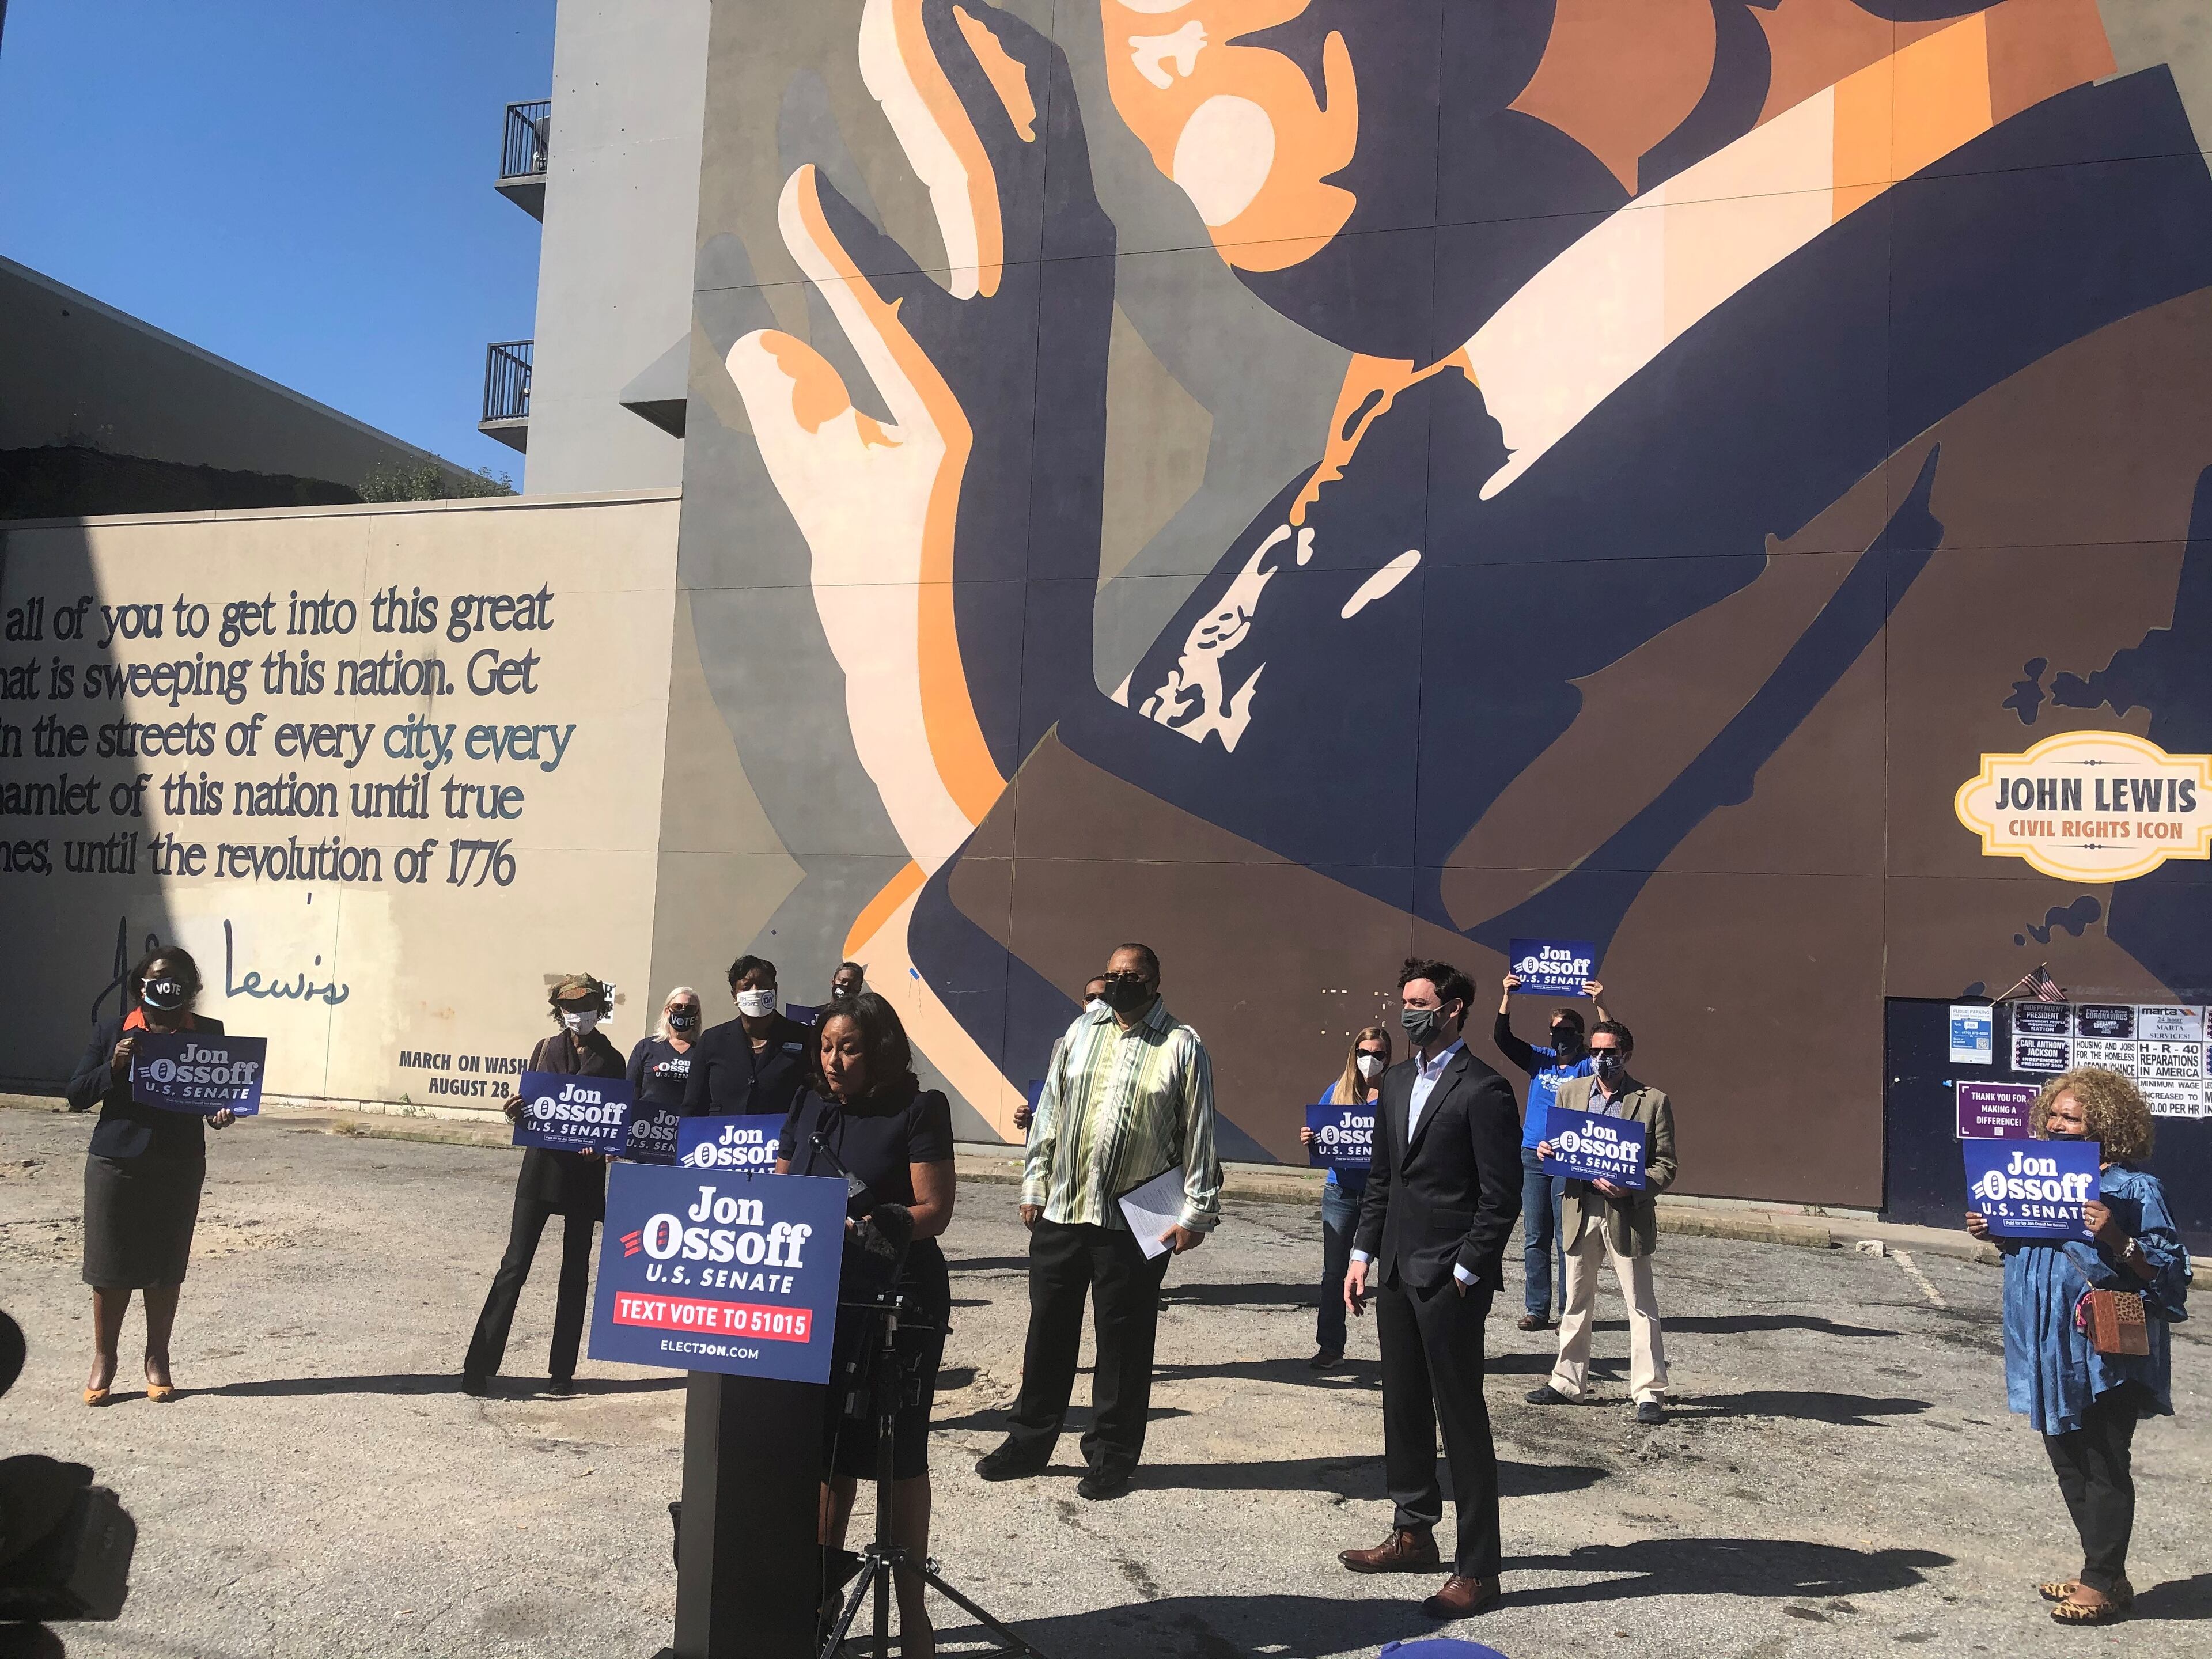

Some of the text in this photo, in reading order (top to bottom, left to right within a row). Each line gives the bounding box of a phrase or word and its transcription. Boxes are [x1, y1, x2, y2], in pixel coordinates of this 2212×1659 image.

[6, 582, 554, 649] all of you to get into this great
[48, 656, 74, 700] is
[83, 651, 252, 707] sweeping
[261, 650, 325, 695] this
[334, 647, 454, 695] nation.
[467, 647, 540, 694] Get
[0, 712, 576, 772] n the streets of every city, every
[0, 771, 525, 819] amlet of this nation until true
[1995, 778, 2196, 812] JOHN LEWIS
[2009, 820, 2183, 839] CIVIL RIGHTS ICON
[64, 831, 139, 875] until
[148, 833, 207, 876] the
[215, 835, 383, 882] revolution
[394, 839, 435, 884] of
[446, 837, 516, 888] 1776
[223, 919, 349, 1005] Lewis
[1540, 946, 1571, 960] Jon
[1522, 956, 1591, 976] Ossoff
[156, 982, 181, 995] VOTE
[1520, 974, 1587, 986] U.S. SENATE
[671, 1014, 695, 1027] VOTE
[2027, 1012, 2059, 1020] PRESIDENT
[2086, 1012, 2128, 1021] CORONAVIRUS
[180, 1044, 229, 1064] Jon
[2027, 1049, 2058, 1058] JACKSON
[2037, 1041, 2065, 1049] ANTHONY
[2077, 1040, 2135, 1051] HOUSING AND JOBS
[2140, 1044, 2198, 1054] H R 40
[399, 1051, 529, 1075] MARCH ON WASH
[2077, 1051, 2135, 1061] FOR THE HOMELESS
[2141, 1054, 2198, 1067] REPARATIONS
[150, 1059, 259, 1085] Ossoff
[2141, 1067, 2199, 1077] IN AMERICA
[146, 1081, 249, 1099] U.S. SENATE
[429, 1077, 487, 1097] AUGUST
[559, 1083, 601, 1104] Jon
[2140, 1080, 2174, 1088] MINIMUM
[1971, 1092, 2027, 1103] THANK YOU FOR
[533, 1096, 627, 1125] Ossoff
[1982, 1105, 2017, 1114] MAKING A
[2169, 1103, 2186, 1114] PER
[2188, 1104, 2199, 1115] HR
[527, 1120, 618, 1139] U.S. SENATE
[632, 1119, 676, 1141] Oss
[1340, 1112, 1375, 1128] Jon
[1976, 1116, 2021, 1127] DIFFERENCE!
[719, 1125, 763, 1145] Jon
[1581, 1120, 1618, 1142] Jon
[626, 1138, 649, 1149] U.S.
[1319, 1146, 1372, 1156] U.S. SEN
[1560, 1131, 1641, 1163] Ossoff
[1555, 1152, 1581, 1165] U.S.
[1586, 1157, 1636, 1175] SENATE
[2007, 1151, 2058, 1176] Jon
[1983, 1170, 2093, 1202] Ossoff
[688, 1185, 764, 1226] Jon
[1982, 1202, 2014, 1217] U.S.
[643, 1213, 812, 1268] Ossoff
[646, 1263, 794, 1294] U.S. SENATE
[620, 1299, 806, 1336] TEXT VOTE TO 51015
[660, 1340, 759, 1360] ELECTJON.COM
